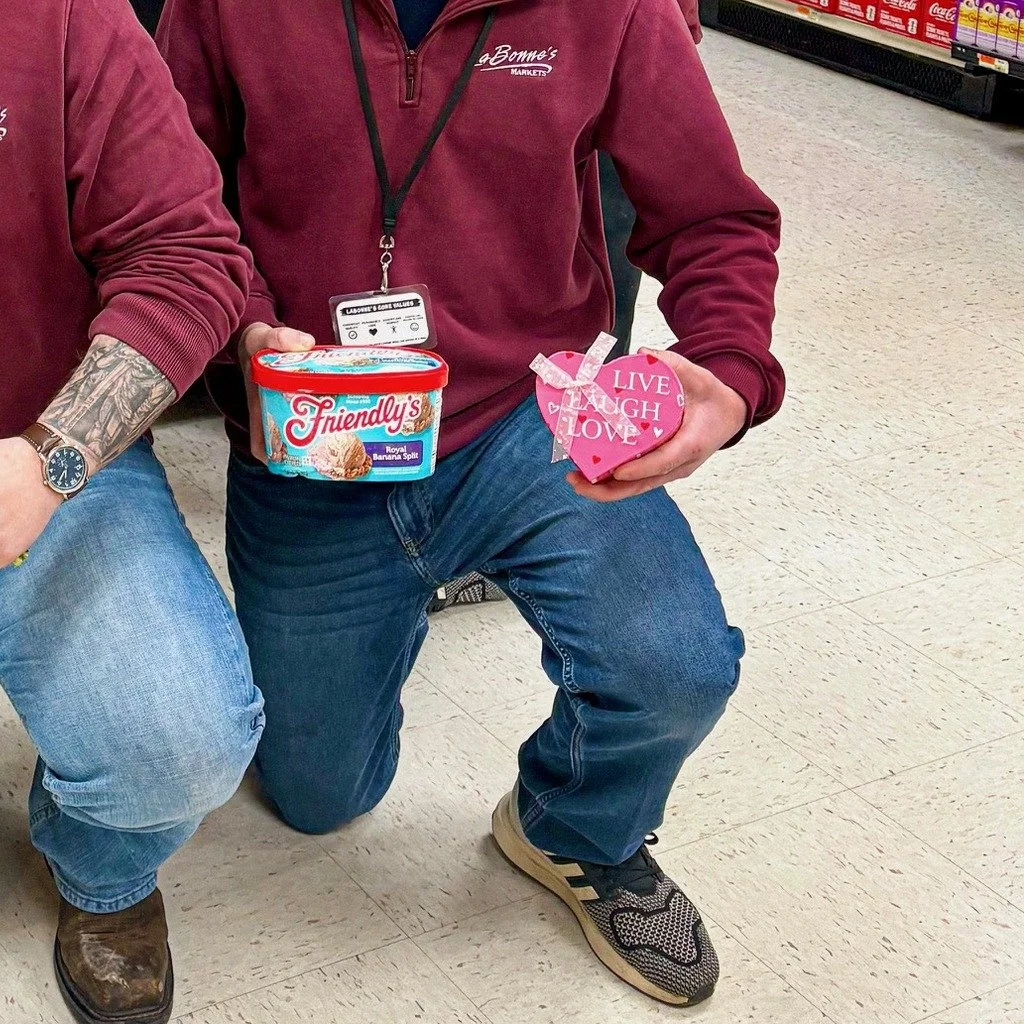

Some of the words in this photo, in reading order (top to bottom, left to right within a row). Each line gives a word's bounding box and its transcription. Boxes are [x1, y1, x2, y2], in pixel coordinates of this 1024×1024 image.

[474, 45, 558, 67] aBonne's
[511, 68, 547, 77] MARKETS
[346, 305, 377, 315] LABONNE'S
[378, 303, 393, 311] CORE
[614, 370, 671, 395] LIVE
[568, 391, 661, 421] LAUGH
[285, 396, 421, 447] Friendly's
[567, 416, 639, 446] LOVE
[385, 445, 407, 454] Royal
[403, 452, 419, 461] Split
